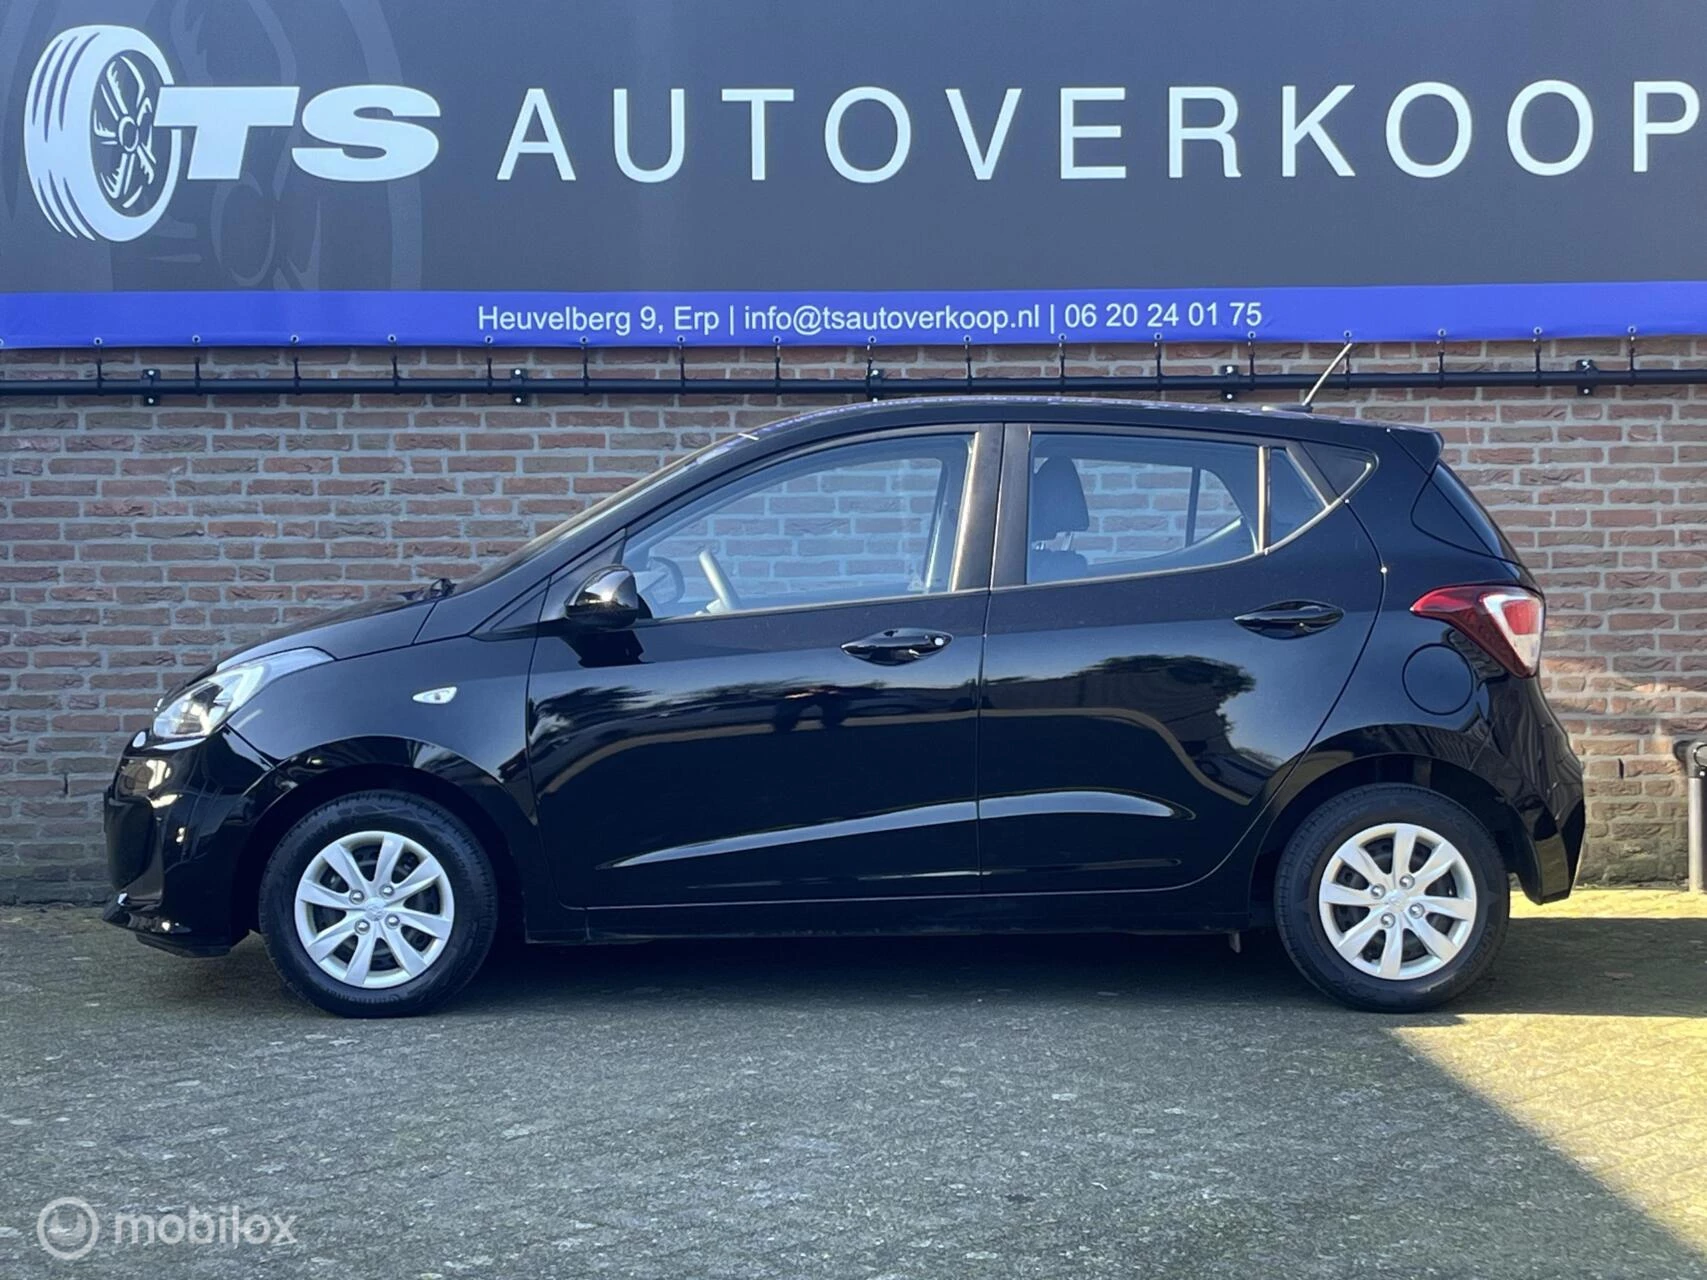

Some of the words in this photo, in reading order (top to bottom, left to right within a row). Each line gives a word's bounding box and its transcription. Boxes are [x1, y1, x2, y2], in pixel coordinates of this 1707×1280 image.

[153, 84, 441, 182] TS
[496, 79, 1702, 184] AUTOVERKOOP
[478, 305, 631, 334] Heuvelberg
[640, 305, 664, 333] 9,
[674, 305, 720, 334] Erp
[744, 303, 1040, 335] info@tsautoverkoop.nl
[1064, 303, 1097, 328] 06
[1105, 303, 1138, 327] 20
[1147, 302, 1180, 327] 24
[1188, 302, 1217, 327] 01
[1229, 302, 1263, 326] 75
